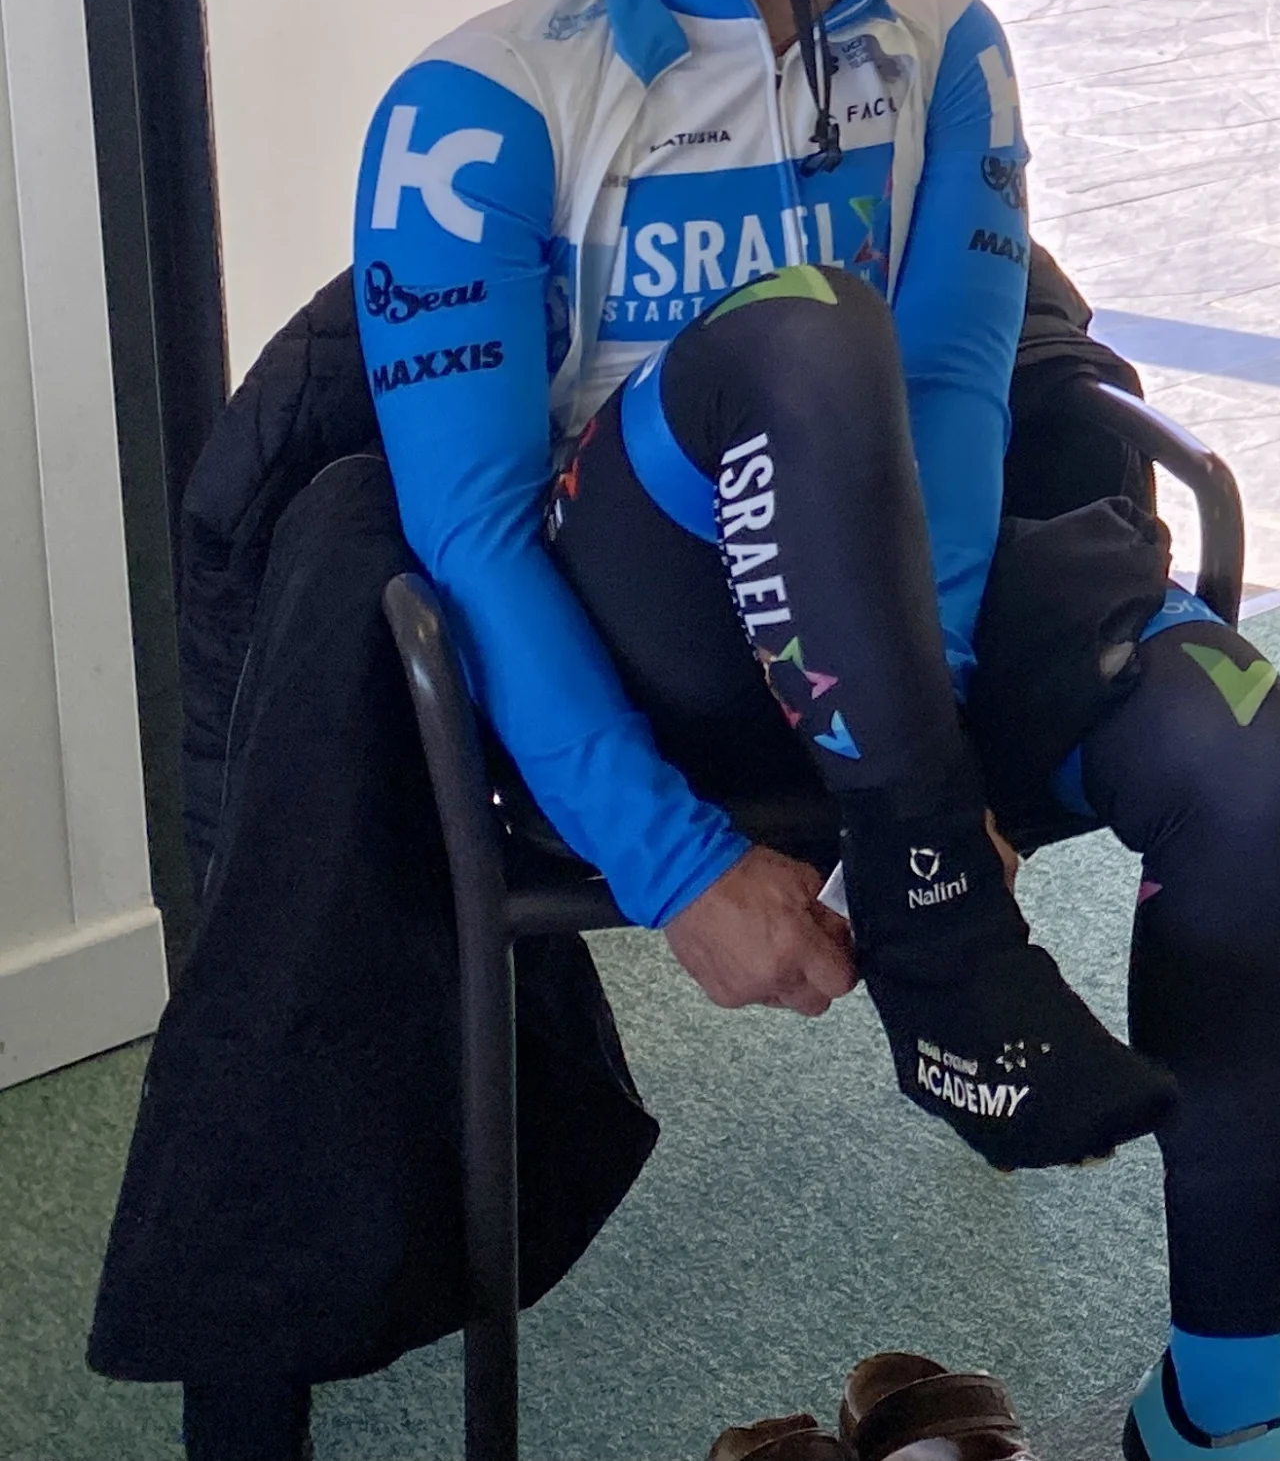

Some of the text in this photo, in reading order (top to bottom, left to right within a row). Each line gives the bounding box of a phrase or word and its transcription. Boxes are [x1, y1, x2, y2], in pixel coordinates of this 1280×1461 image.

[607, 202, 845, 298] ISRAEL
[371, 341, 504, 395] MAXXIS
[720, 433, 791, 637] ISRAEL
[908, 872, 968, 909] Nalini
[918, 1057, 1029, 1118] ACADEMY
